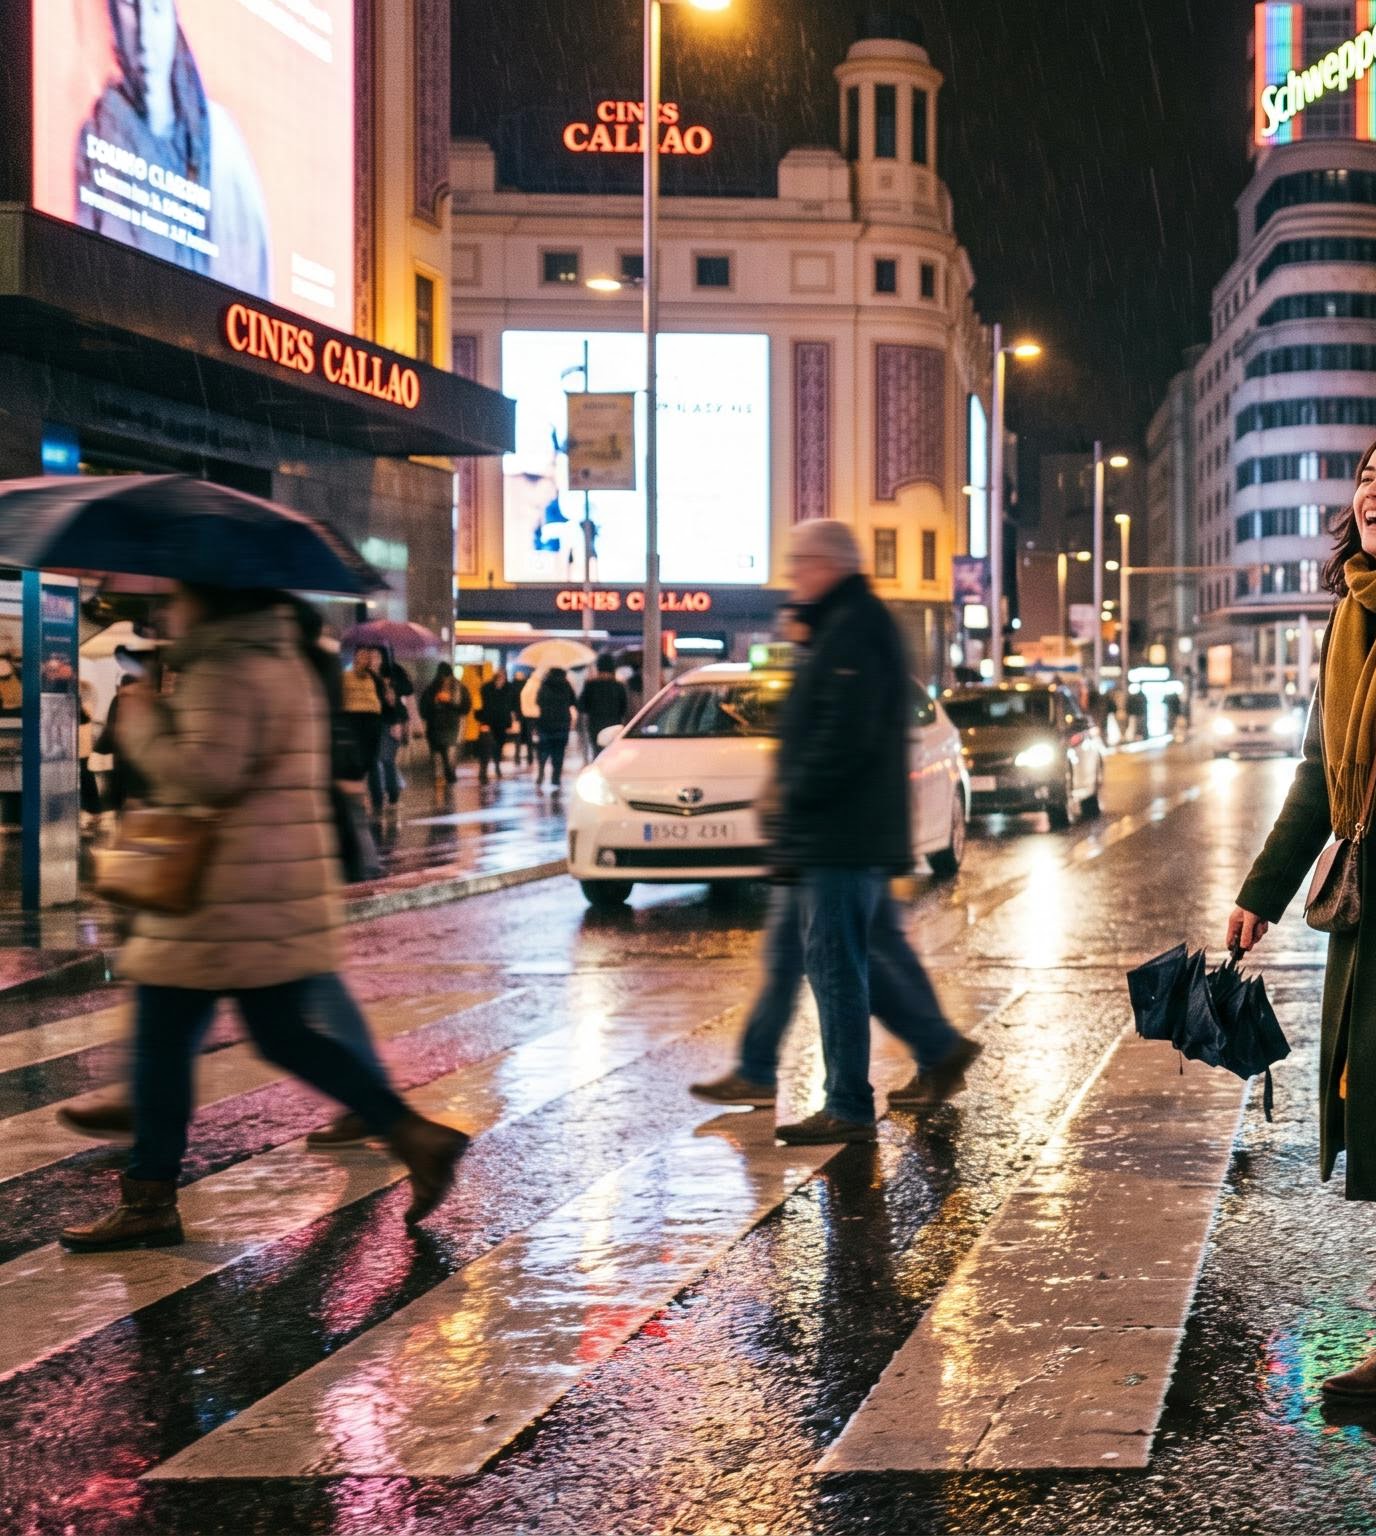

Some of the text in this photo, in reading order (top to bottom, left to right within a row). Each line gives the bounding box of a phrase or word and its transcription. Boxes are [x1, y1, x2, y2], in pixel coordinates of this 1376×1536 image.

[597, 101, 679, 125] CINS
[226, 303, 420, 409] CINES CALLAO
